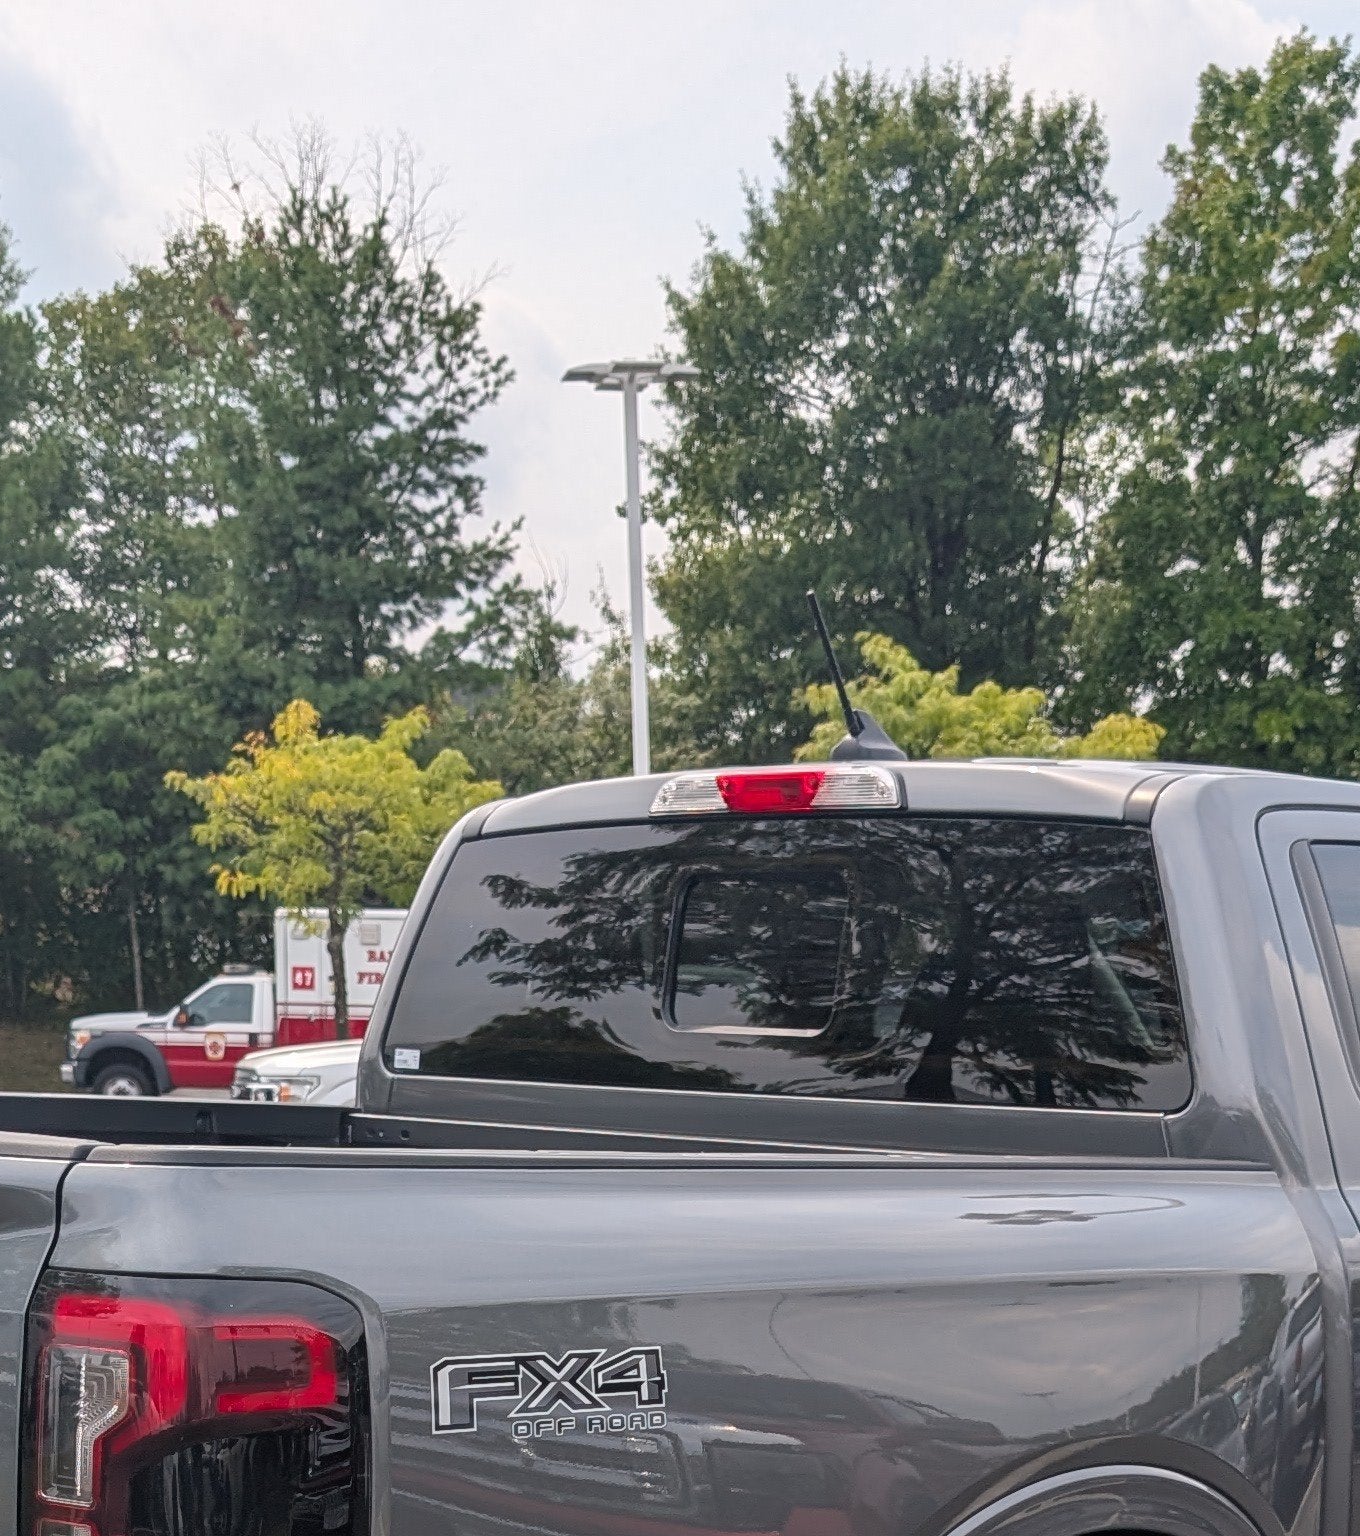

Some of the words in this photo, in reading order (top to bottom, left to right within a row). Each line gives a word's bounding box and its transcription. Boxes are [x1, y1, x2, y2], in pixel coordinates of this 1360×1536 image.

[356, 972, 385, 984] FIR
[430, 1346, 668, 1434] FX4
[511, 1417, 576, 1439] OFF
[586, 1410, 667, 1434] ROAD
